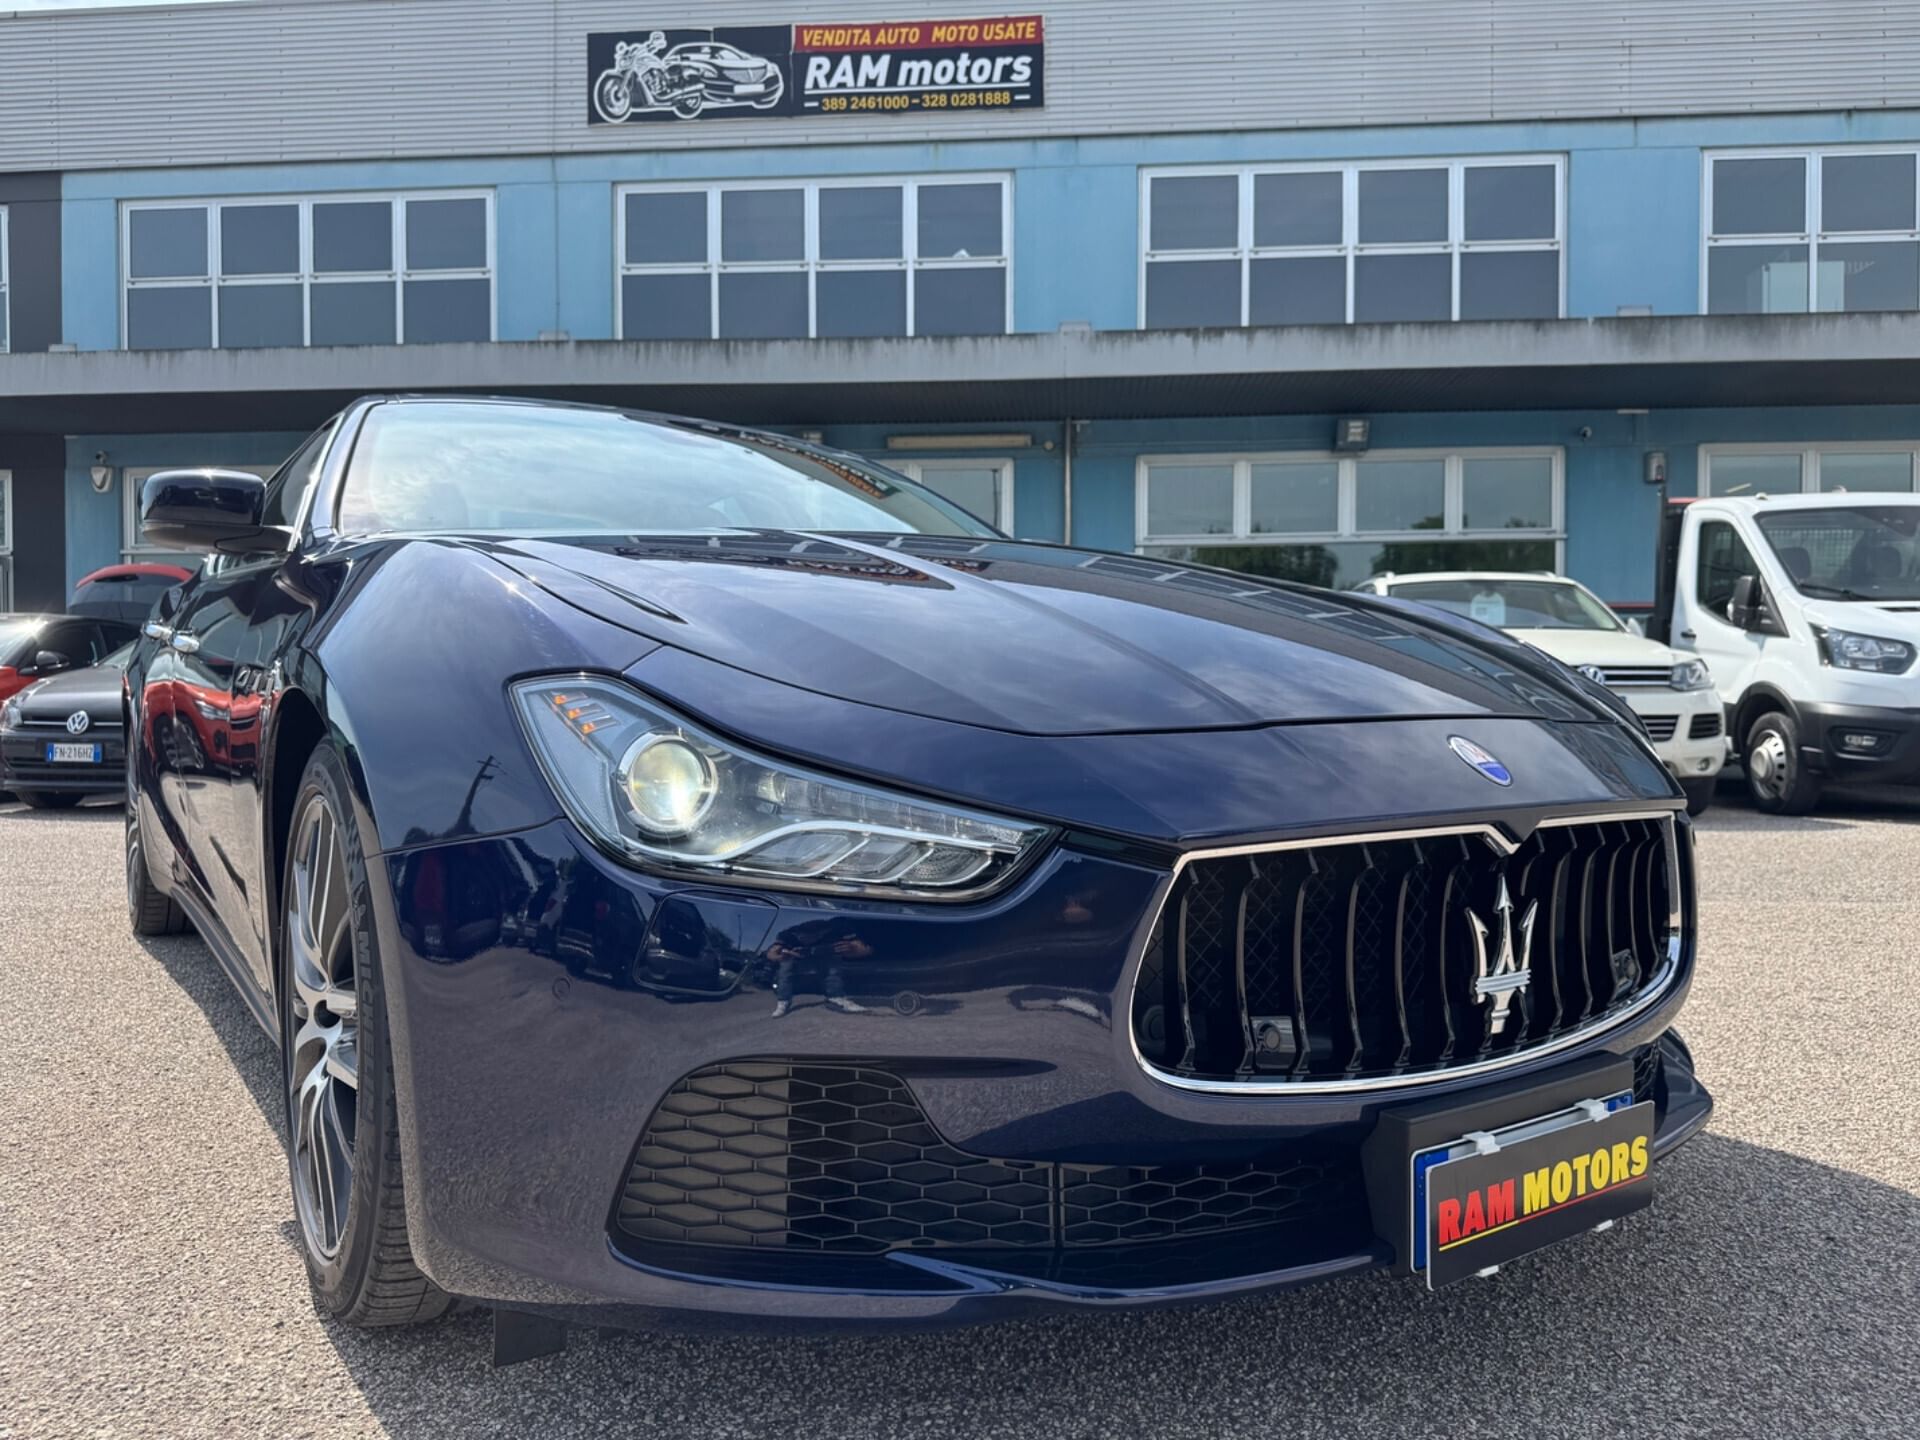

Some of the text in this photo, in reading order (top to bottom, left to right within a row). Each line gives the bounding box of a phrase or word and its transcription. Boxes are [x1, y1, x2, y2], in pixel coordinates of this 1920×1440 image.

[802, 21, 1037, 47] VENDITA AUTO MOTO USATE
[804, 52, 1033, 90] RAM motors
[821, 96, 848, 112] 389
[850, 94, 910, 111] 2461000
[921, 93, 948, 108] 328
[951, 90, 1011, 107] 0281888
[1437, 1135, 1649, 1246] RAM MOTORS
